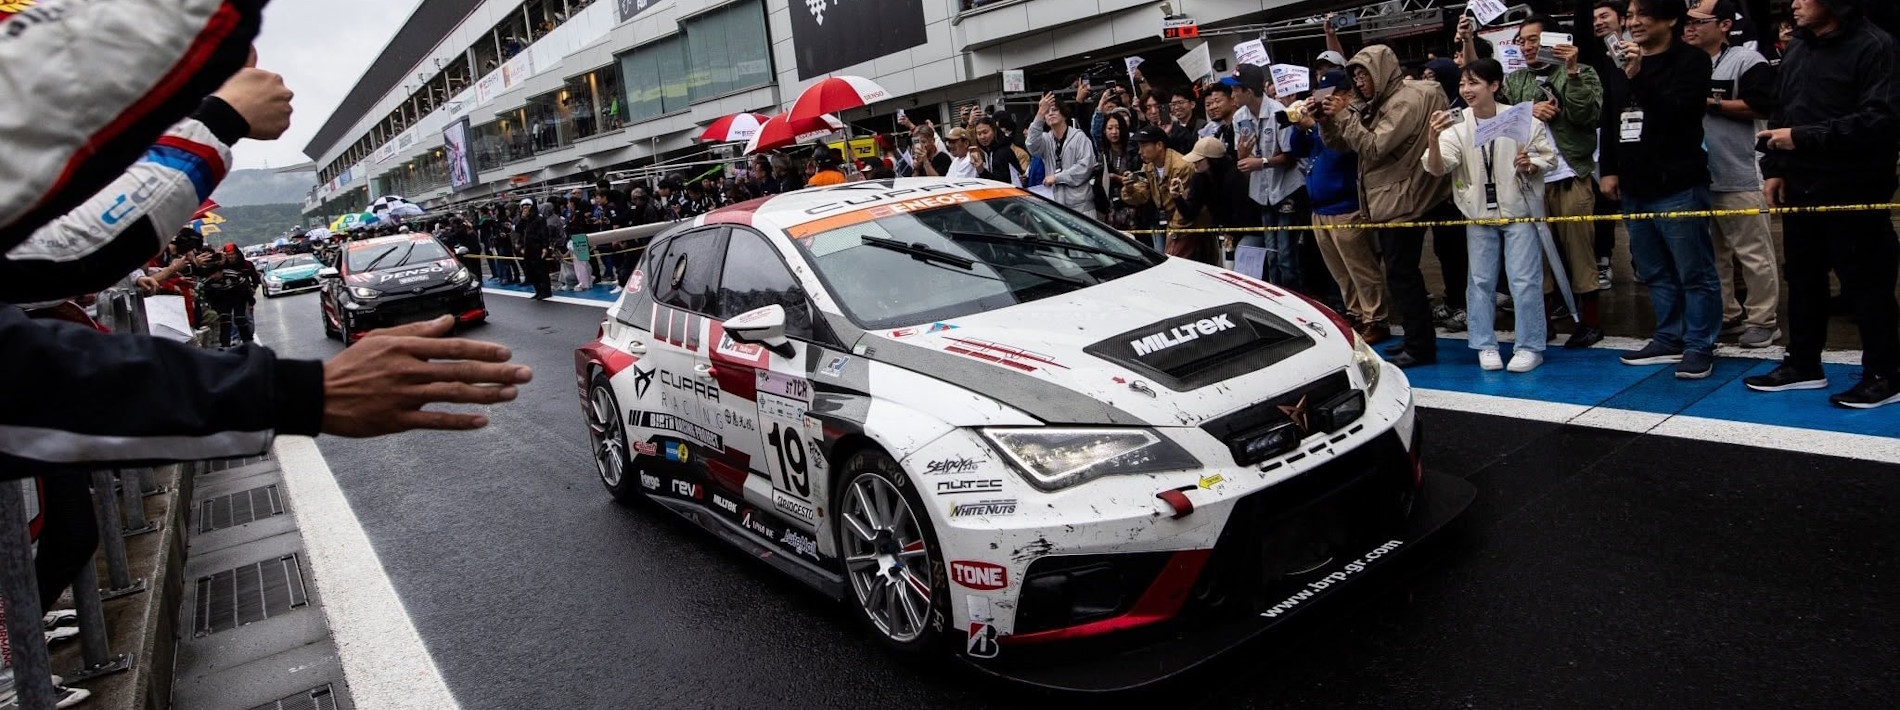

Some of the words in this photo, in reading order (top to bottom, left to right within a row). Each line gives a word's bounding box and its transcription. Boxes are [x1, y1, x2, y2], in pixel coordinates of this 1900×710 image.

[855, 146, 872, 154] 72
[805, 181, 984, 215] CUPRA
[890, 192, 970, 213] ENEOS
[380, 266, 444, 283] DENSO
[660, 369, 720, 404] CUPRA
[661, 391, 724, 430] RACING
[767, 421, 811, 498] 19
[671, 478, 704, 500] revo
[937, 479, 1003, 491] NUTEC
[952, 563, 1004, 587] TONE
[1259, 538, 1404, 619] www.brp.gr.com
